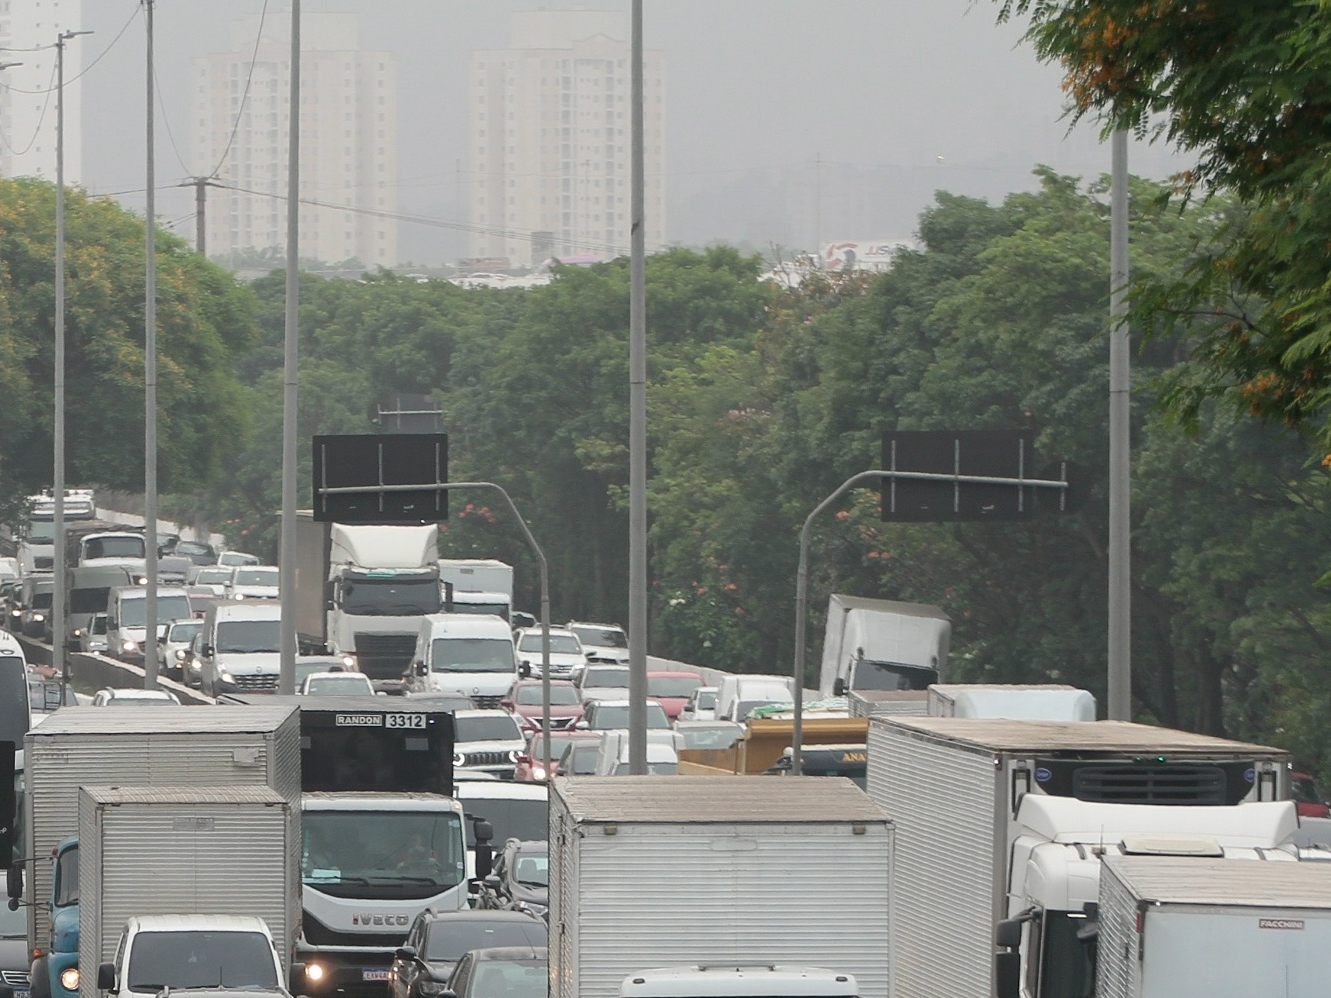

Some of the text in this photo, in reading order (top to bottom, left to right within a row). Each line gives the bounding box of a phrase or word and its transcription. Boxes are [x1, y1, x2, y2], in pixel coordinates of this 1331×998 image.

[337, 716, 381, 725] RANDON
[389, 715, 423, 727] 3312
[352, 913, 409, 926] IVECO
[1260, 920, 1303, 929] FACCHINI
